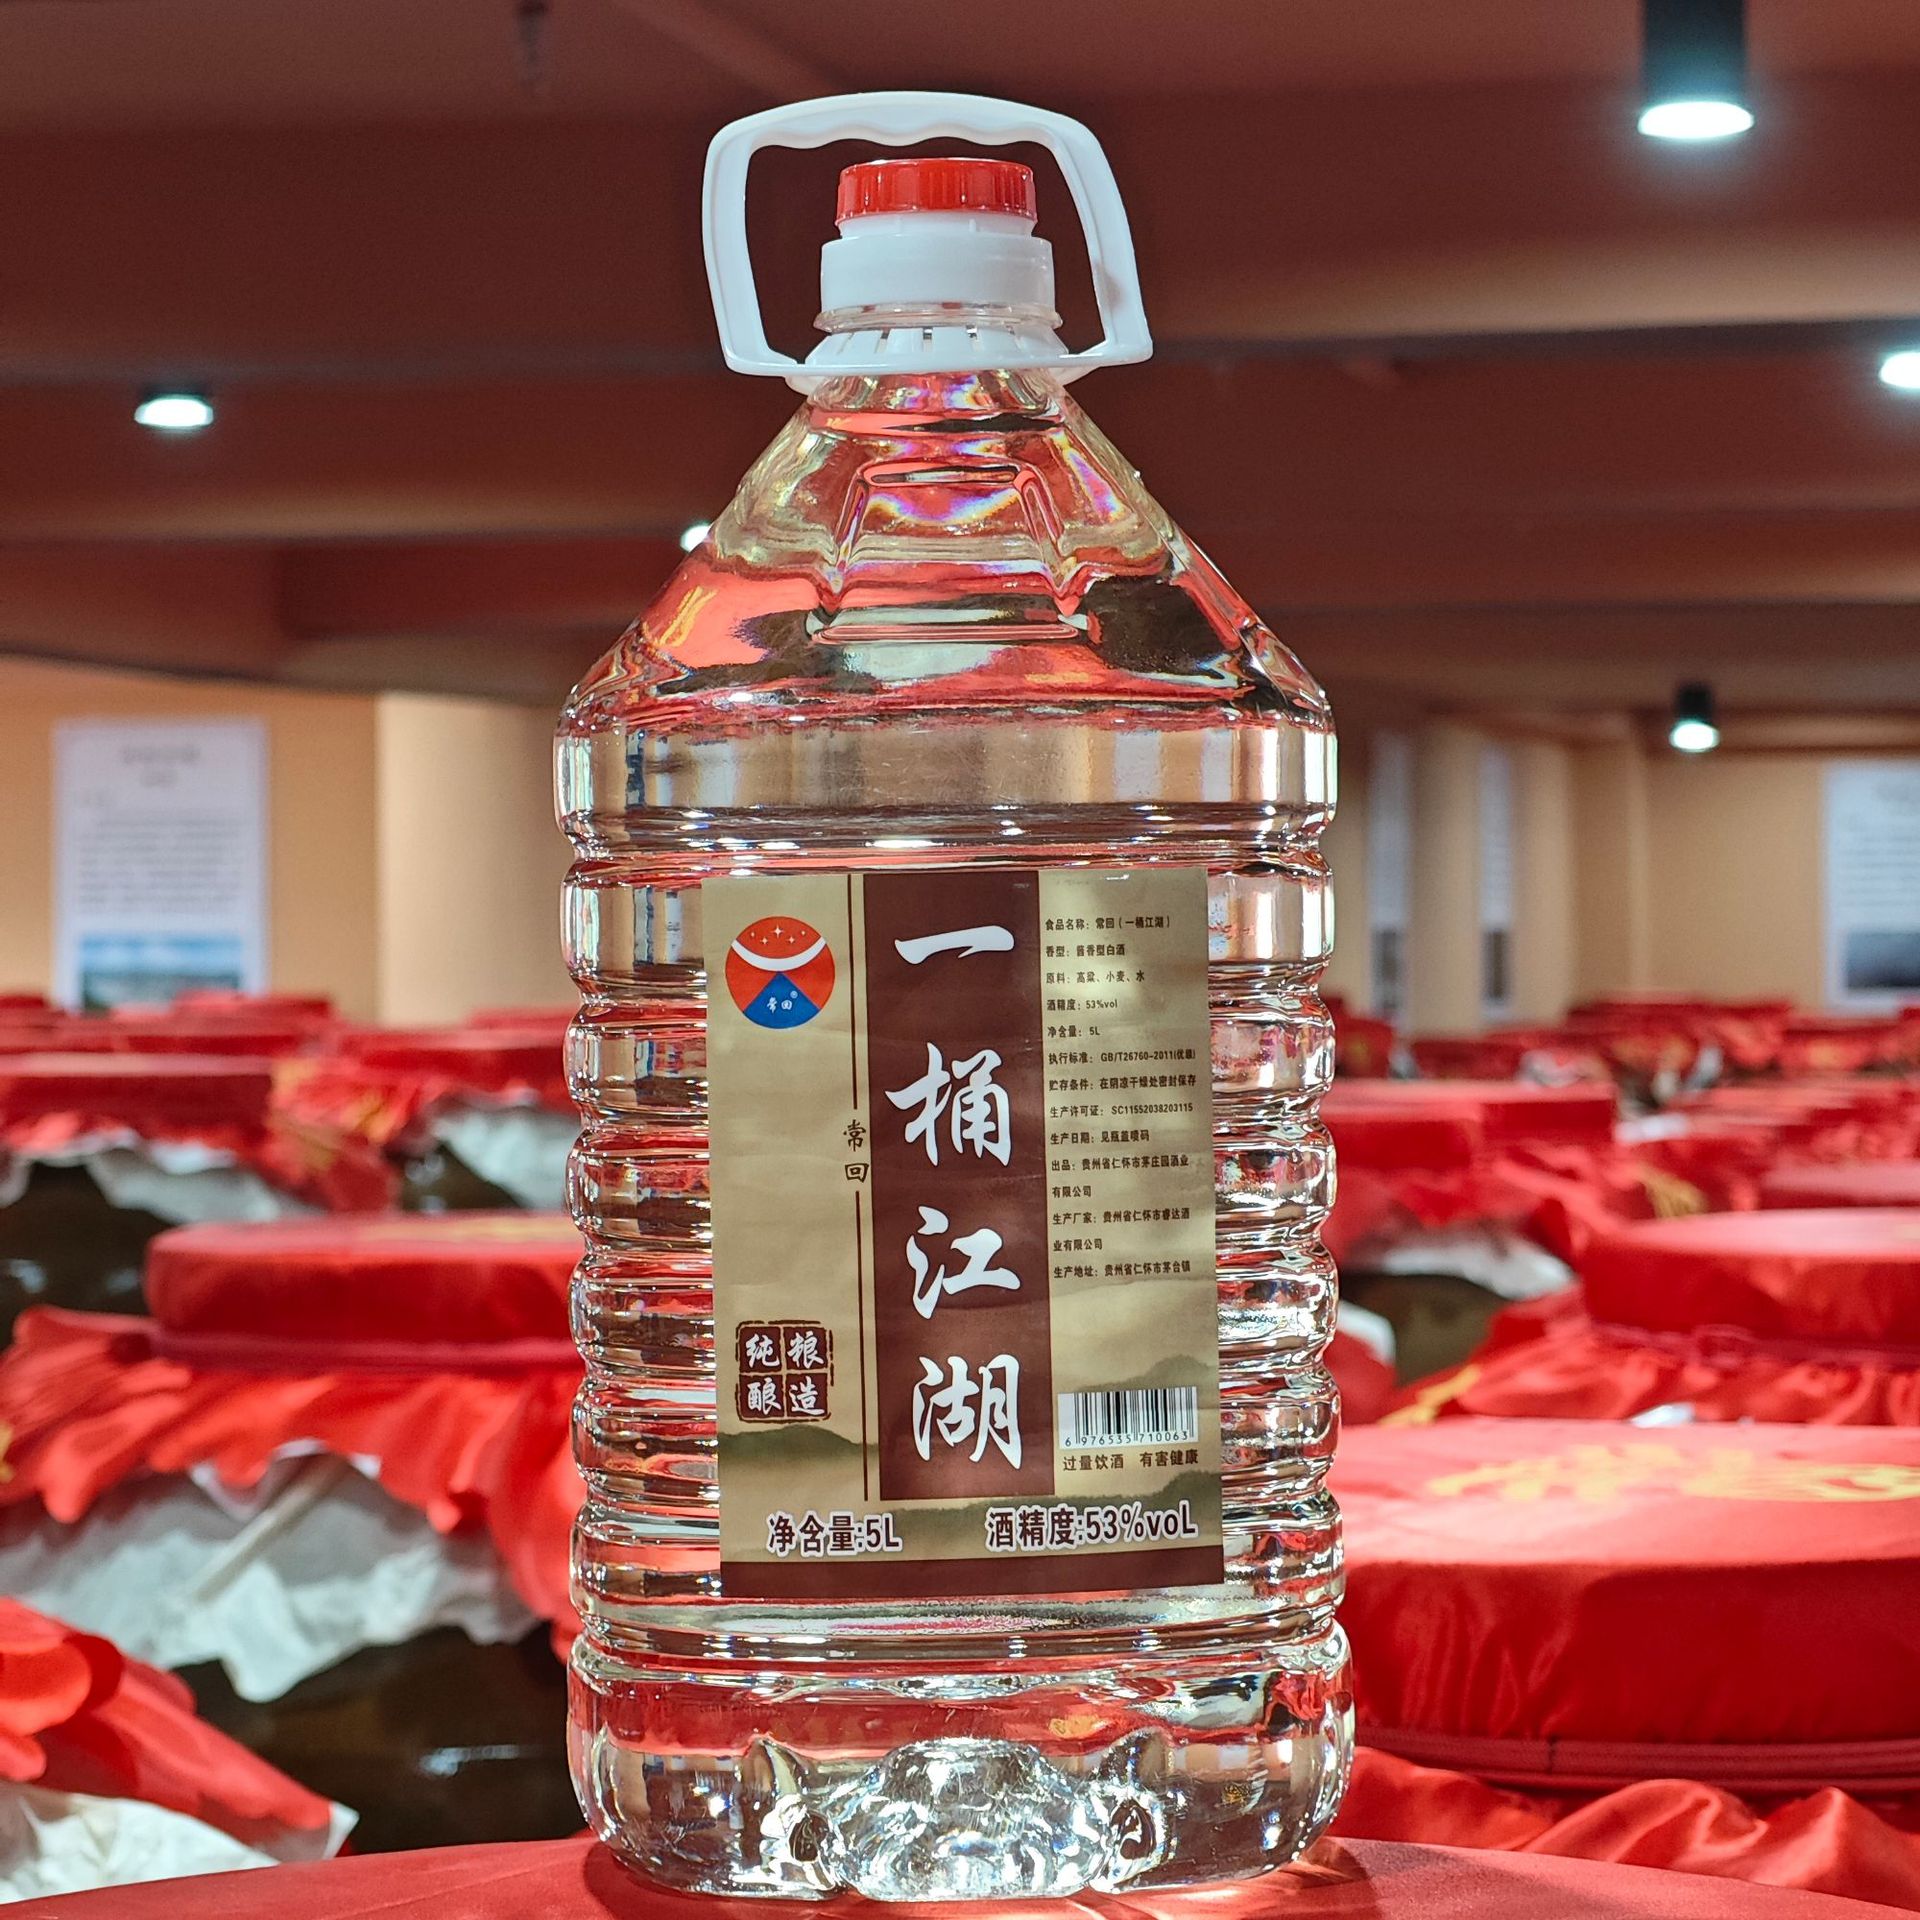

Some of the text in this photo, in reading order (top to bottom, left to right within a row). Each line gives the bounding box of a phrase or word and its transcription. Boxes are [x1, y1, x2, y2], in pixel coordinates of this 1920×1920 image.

[843, 1119, 869, 1183] 常回
[885, 925, 1022, 1470] 一桶江湖
[1052, 1186, 1092, 1198] 有限公司
[1053, 1238, 1103, 1252] 业有限公司
[1063, 1449, 1199, 1471] 过量饮酒 有害健康
[767, 1512, 902, 1556] 净含量:5L
